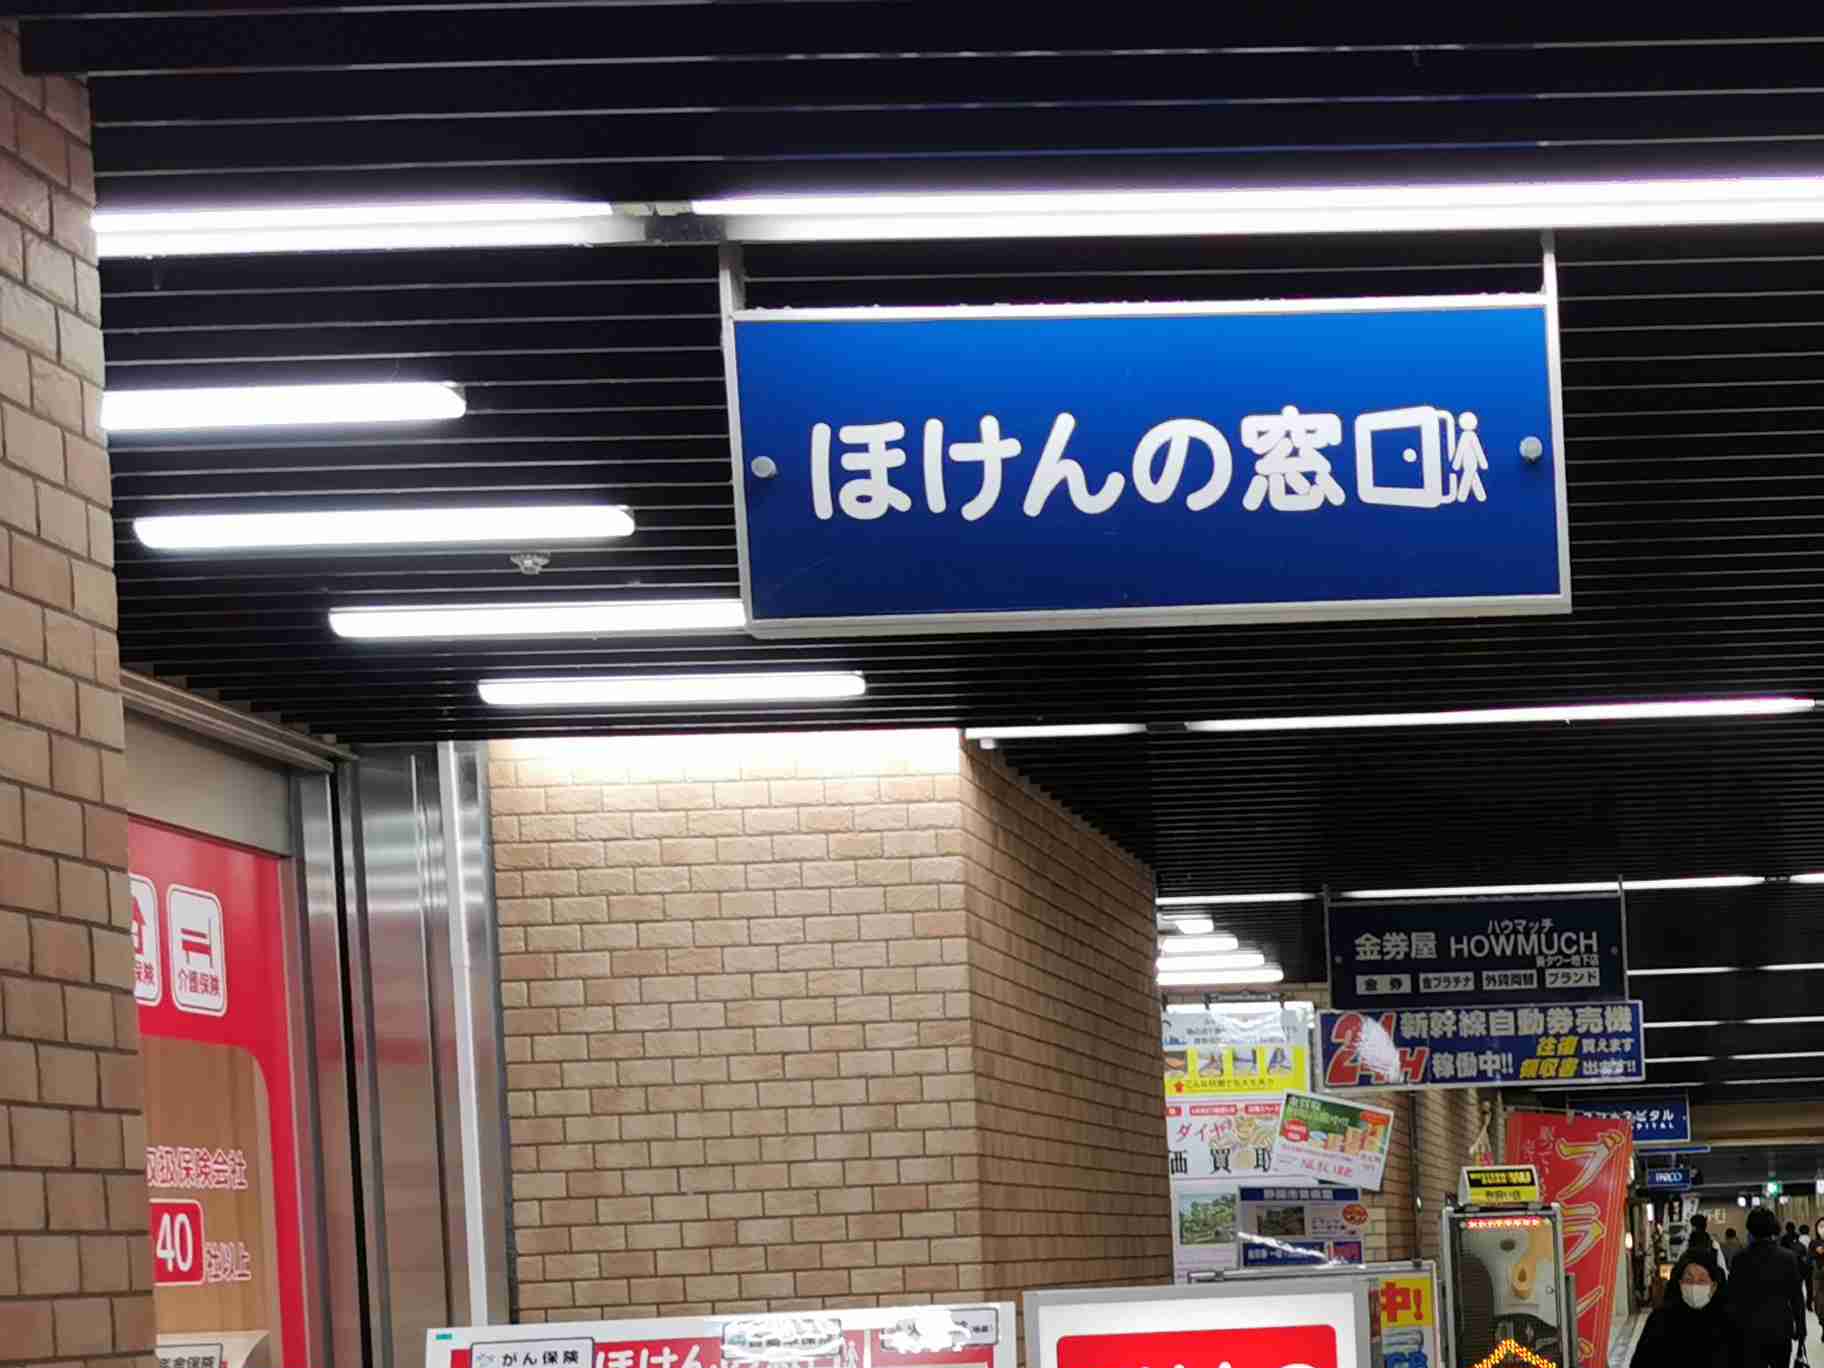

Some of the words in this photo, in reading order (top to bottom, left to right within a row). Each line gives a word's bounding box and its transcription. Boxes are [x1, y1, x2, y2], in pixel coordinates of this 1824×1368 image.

[810, 404, 1457, 522] ほけんの窓口
[1487, 918, 1554, 934] ハウマッチ
[1354, 931, 1438, 961] 金券屋
[1450, 930, 1599, 959] HOWMUCH
[1547, 969, 1599, 986] ブランド
[1400, 1005, 1633, 1041] 新幹線自動券売機
[156, 1212, 193, 1273] 40
[501, 1351, 579, 1367] がん保険
